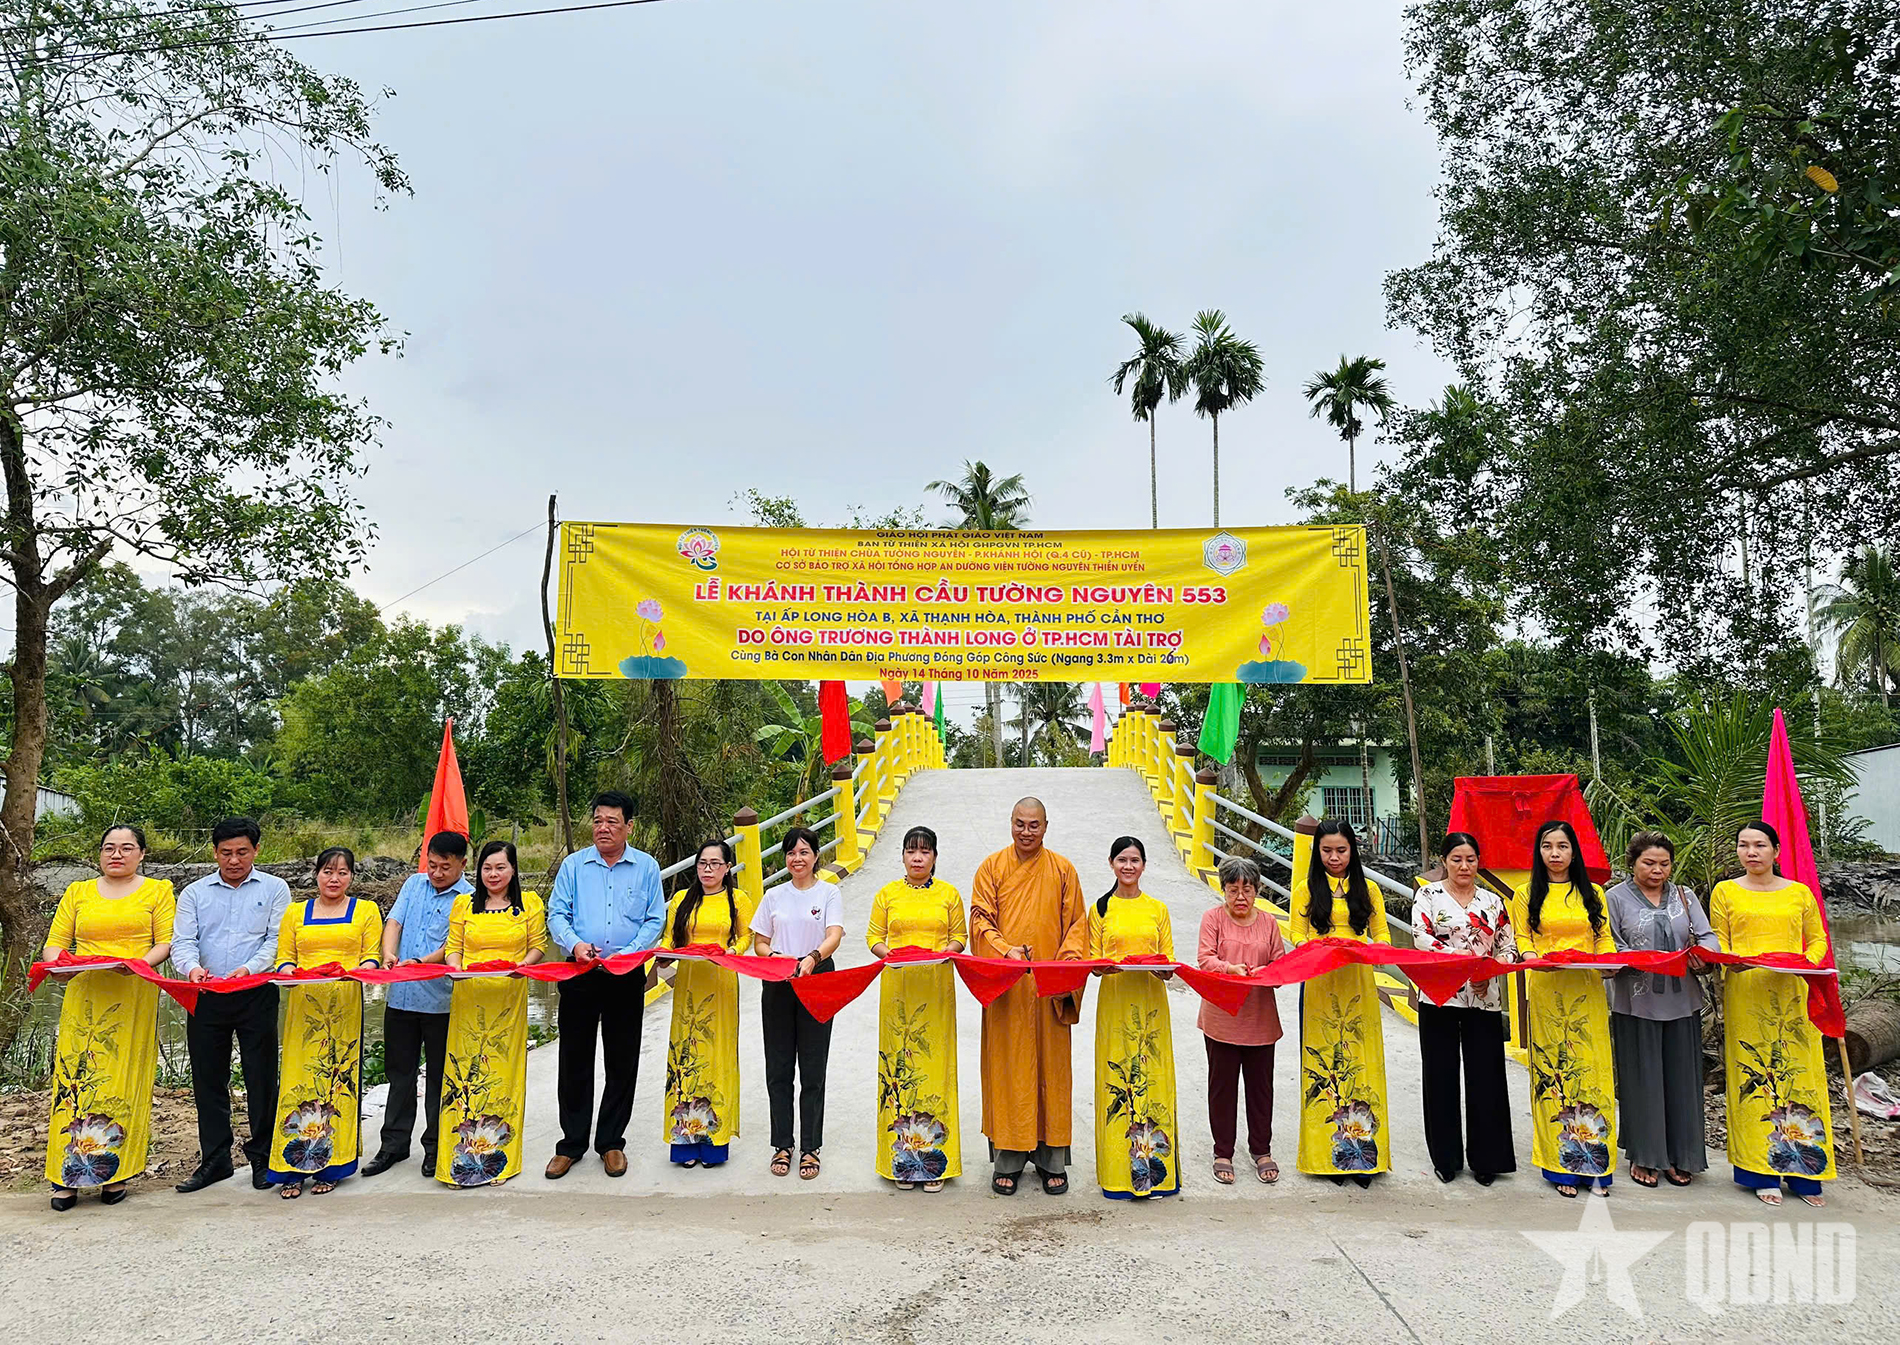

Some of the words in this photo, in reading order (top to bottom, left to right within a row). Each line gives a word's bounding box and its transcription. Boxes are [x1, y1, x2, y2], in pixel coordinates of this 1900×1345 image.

[909, 531, 928, 540] HỘI
[932, 531, 958, 540] PHẬT
[994, 531, 1014, 540] VIỆT
[950, 541, 970, 549] HỘI
[781, 548, 800, 558] HỘI
[803, 548, 815, 556] TỪ
[819, 548, 846, 559] THIỆN
[850, 548, 880, 557] CHÙA
[884, 549, 920, 557] TƯỜNG
[924, 549, 965, 558] NGUYÊN
[974, 550, 1020, 558] P.KHÁNH
[1024, 550, 1042, 560] HỘI
[1046, 551, 1068, 560] (Q.4
[1072, 550, 1092, 560] CŨ)
[794, 560, 806, 569] SỞ
[809, 560, 828, 569] BẢO
[832, 561, 849, 571] TRỢ
[852, 561, 865, 569] XÃ
[868, 561, 884, 572] HỘI
[918, 562, 936, 572] HỢP
[994, 562, 1014, 572] VIỆN
[1017, 562, 1049, 570] TƯỜNG
[1052, 562, 1089, 571] NGUYÊN
[696, 578, 720, 599] LỄ
[728, 581, 814, 600] KHÁNH
[823, 582, 906, 601] THÀNH
[915, 579, 968, 602] CẦU
[976, 582, 1063, 602] TƯỜNG
[1072, 583, 1173, 603] NGUYÊN
[1182, 588, 1226, 603] 553
[756, 611, 776, 623] TẠI
[781, 607, 799, 621] ẤP
[804, 612, 842, 622] LONG
[848, 610, 877, 622] HÒA
[883, 613, 894, 623] B,
[900, 610, 919, 622] XÃ
[924, 613, 970, 625] THẠNH
[975, 612, 1010, 624] HÒA,
[1015, 611, 1061, 623] THÀNH
[1067, 610, 1096, 623] PHỐ
[1137, 613, 1164, 623] THƠ
[738, 630, 765, 643] DO
[771, 626, 813, 643] ÔNG
[819, 629, 893, 644] TRƯƠNG
[899, 628, 959, 644] THÀNH
[966, 631, 1016, 645] LONG
[1022, 627, 1036, 645] Ở
[1042, 632, 1108, 646] TP.HCM
[1114, 628, 1140, 646] TÀI
[1147, 632, 1182, 650] TRỢ
[731, 650, 760, 663] Cùng
[765, 651, 778, 660] Bà
[782, 652, 804, 660] Con
[809, 651, 836, 661] Nhân
[841, 652, 862, 661] Dân
[866, 652, 884, 664] Địa
[889, 652, 929, 664] Phương
[934, 653, 962, 665] Đóng
[967, 653, 990, 664] Góp
[994, 652, 1023, 665] Công
[1028, 653, 1047, 662] Sức
[1052, 653, 1093, 665] (Ngang
[1097, 654, 1123, 663] 3.3m
[1138, 654, 1156, 663] Dài
[880, 668, 908, 679] Ngày
[913, 669, 924, 678] 14
[929, 669, 962, 680] Tháng
[967, 670, 978, 678] 10
[983, 670, 1008, 678] Năm
[1012, 670, 1038, 678] 2025
